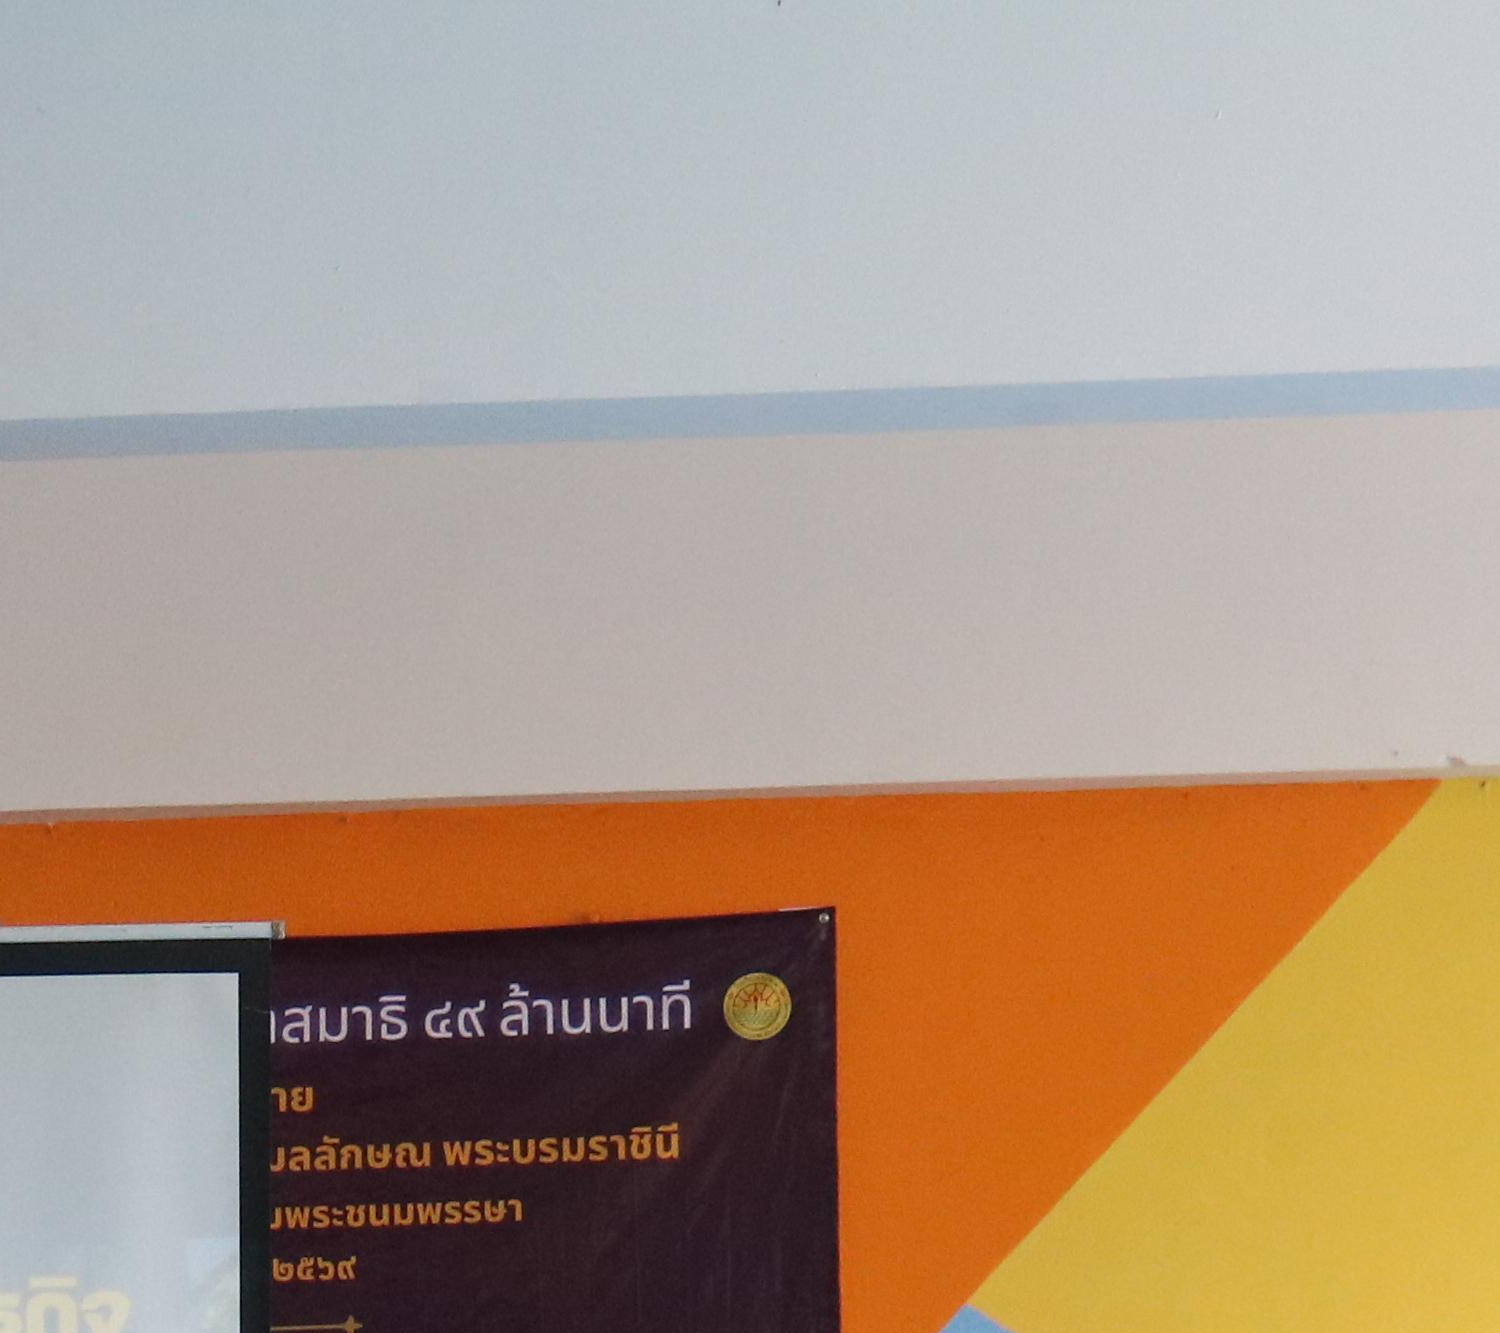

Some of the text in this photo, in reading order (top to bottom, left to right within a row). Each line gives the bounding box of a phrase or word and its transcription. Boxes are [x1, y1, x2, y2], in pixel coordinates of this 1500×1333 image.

[424, 1000, 487, 1039] ๔๙
[500, 979, 692, 1037] ล้านนาที
[270, 1086, 314, 1113] าย
[442, 1121, 681, 1167] พระบรมราชินี
[272, 1256, 358, 1282] ๒๕๖๙
